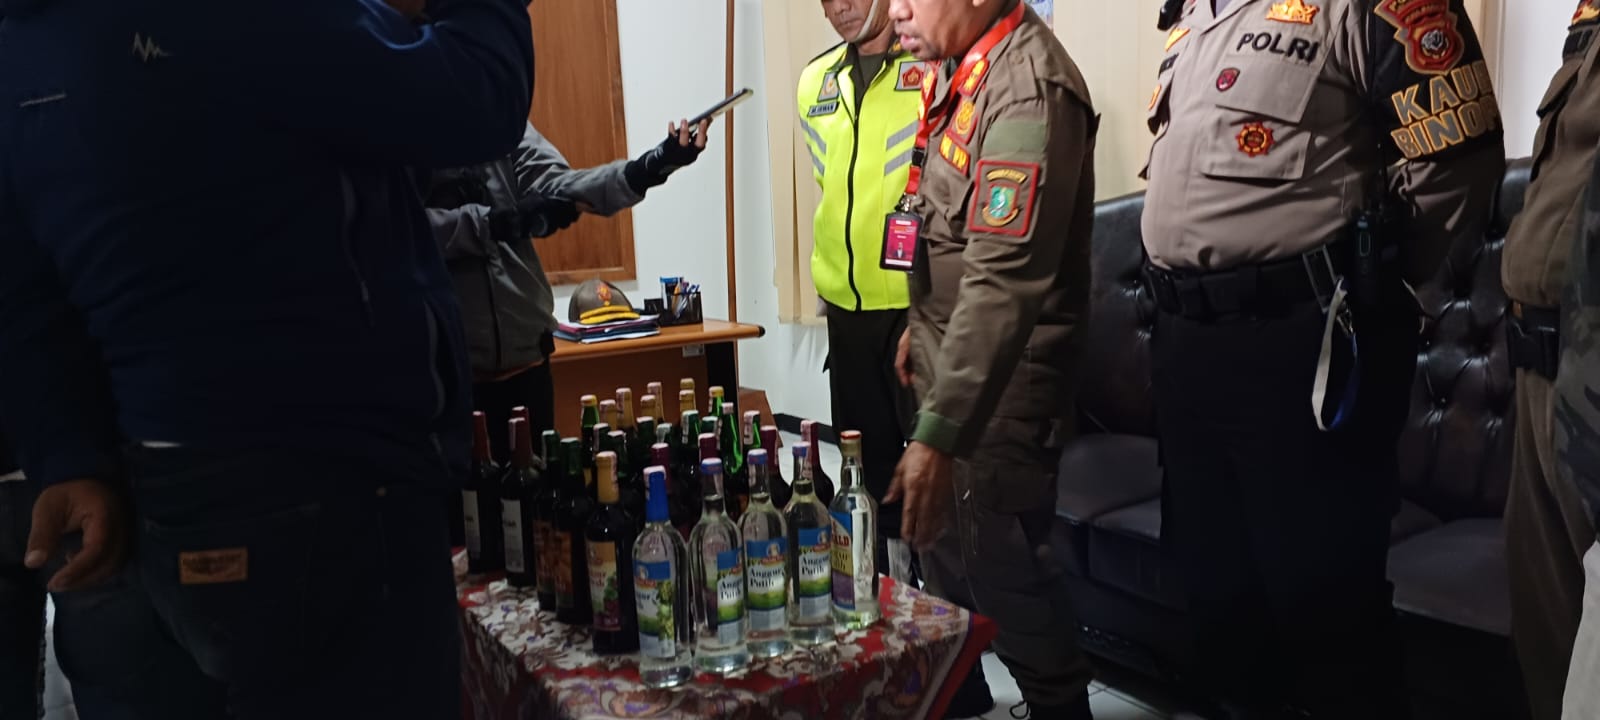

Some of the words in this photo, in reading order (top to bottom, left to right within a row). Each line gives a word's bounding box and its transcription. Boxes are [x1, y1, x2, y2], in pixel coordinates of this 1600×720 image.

[1237, 32, 1320, 63] POLRI
[750, 566, 783, 579] Anggur
[750, 576, 774, 588] Putih
